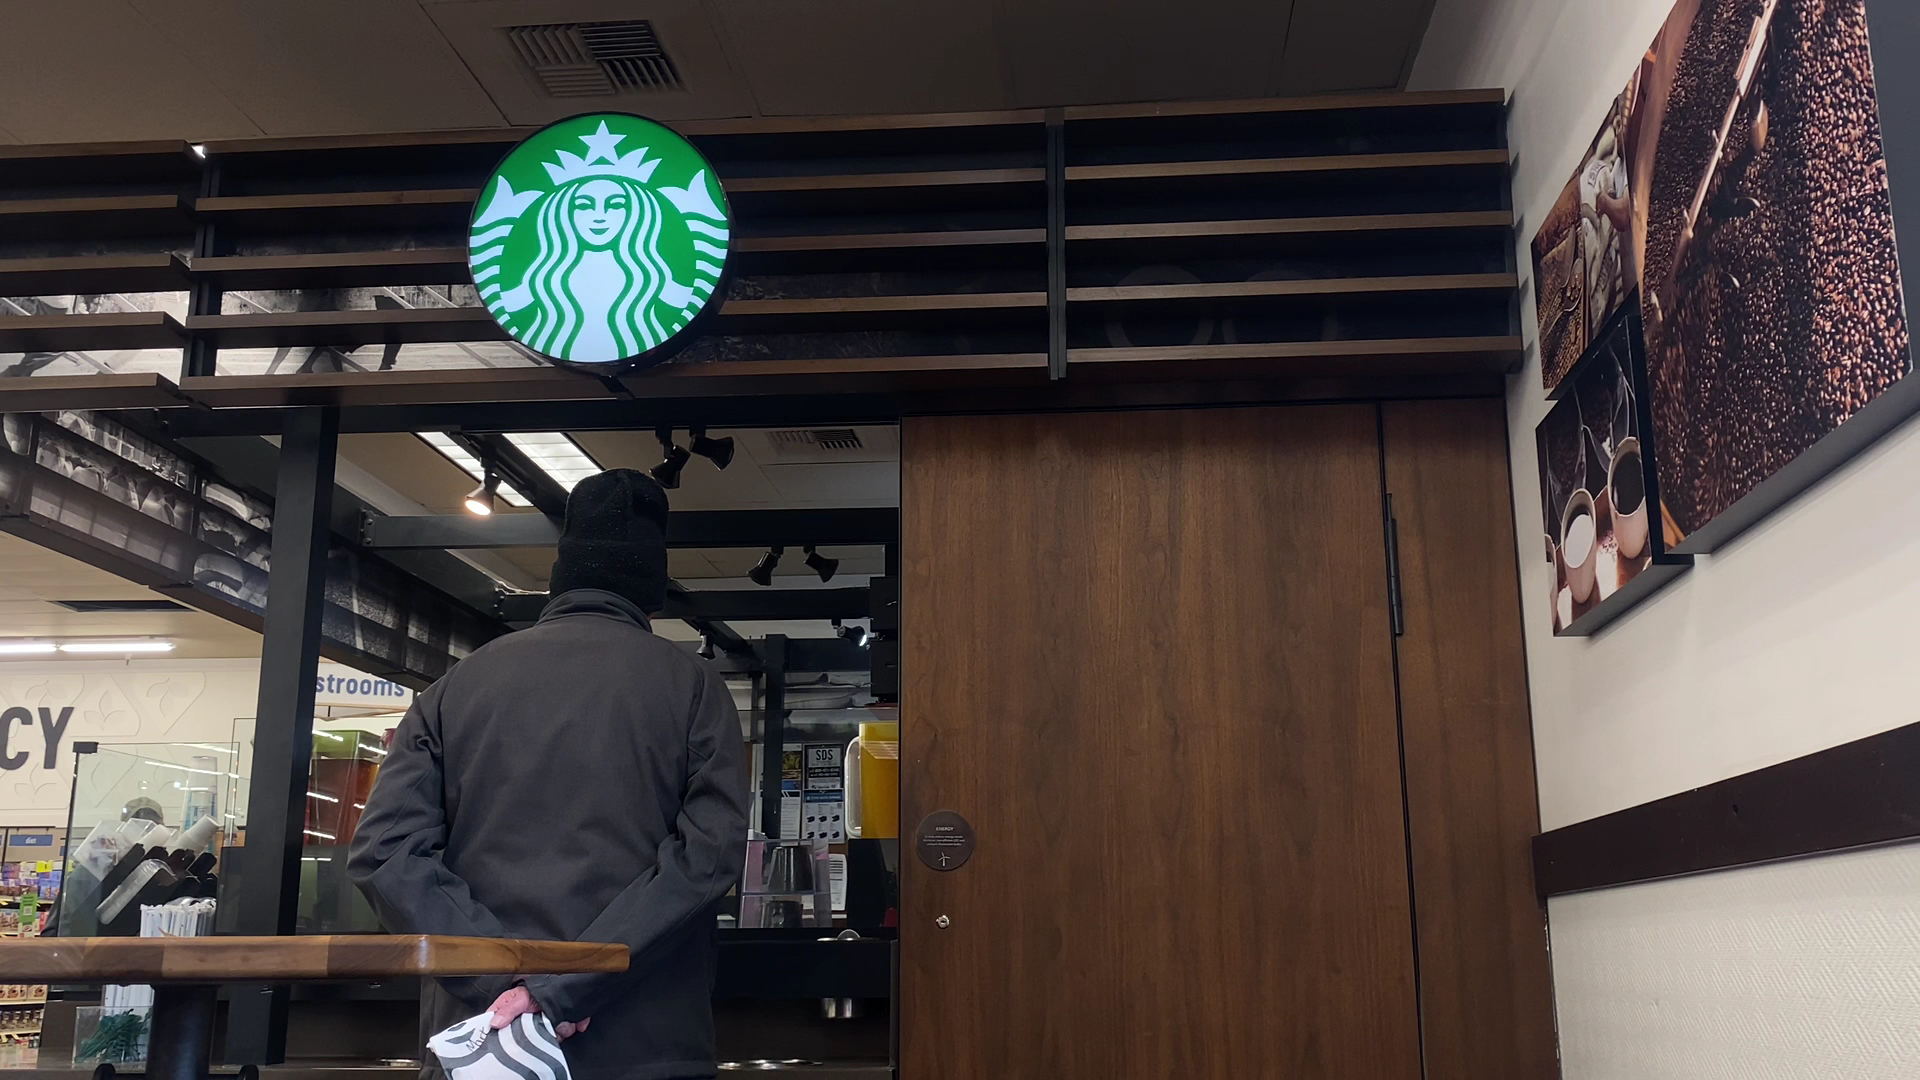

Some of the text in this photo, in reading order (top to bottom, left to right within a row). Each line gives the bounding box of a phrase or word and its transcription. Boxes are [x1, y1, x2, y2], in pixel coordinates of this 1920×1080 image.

[316, 674, 405, 697] strooms
[0, 706, 74, 770] CY
[815, 749, 833, 760] SDS
